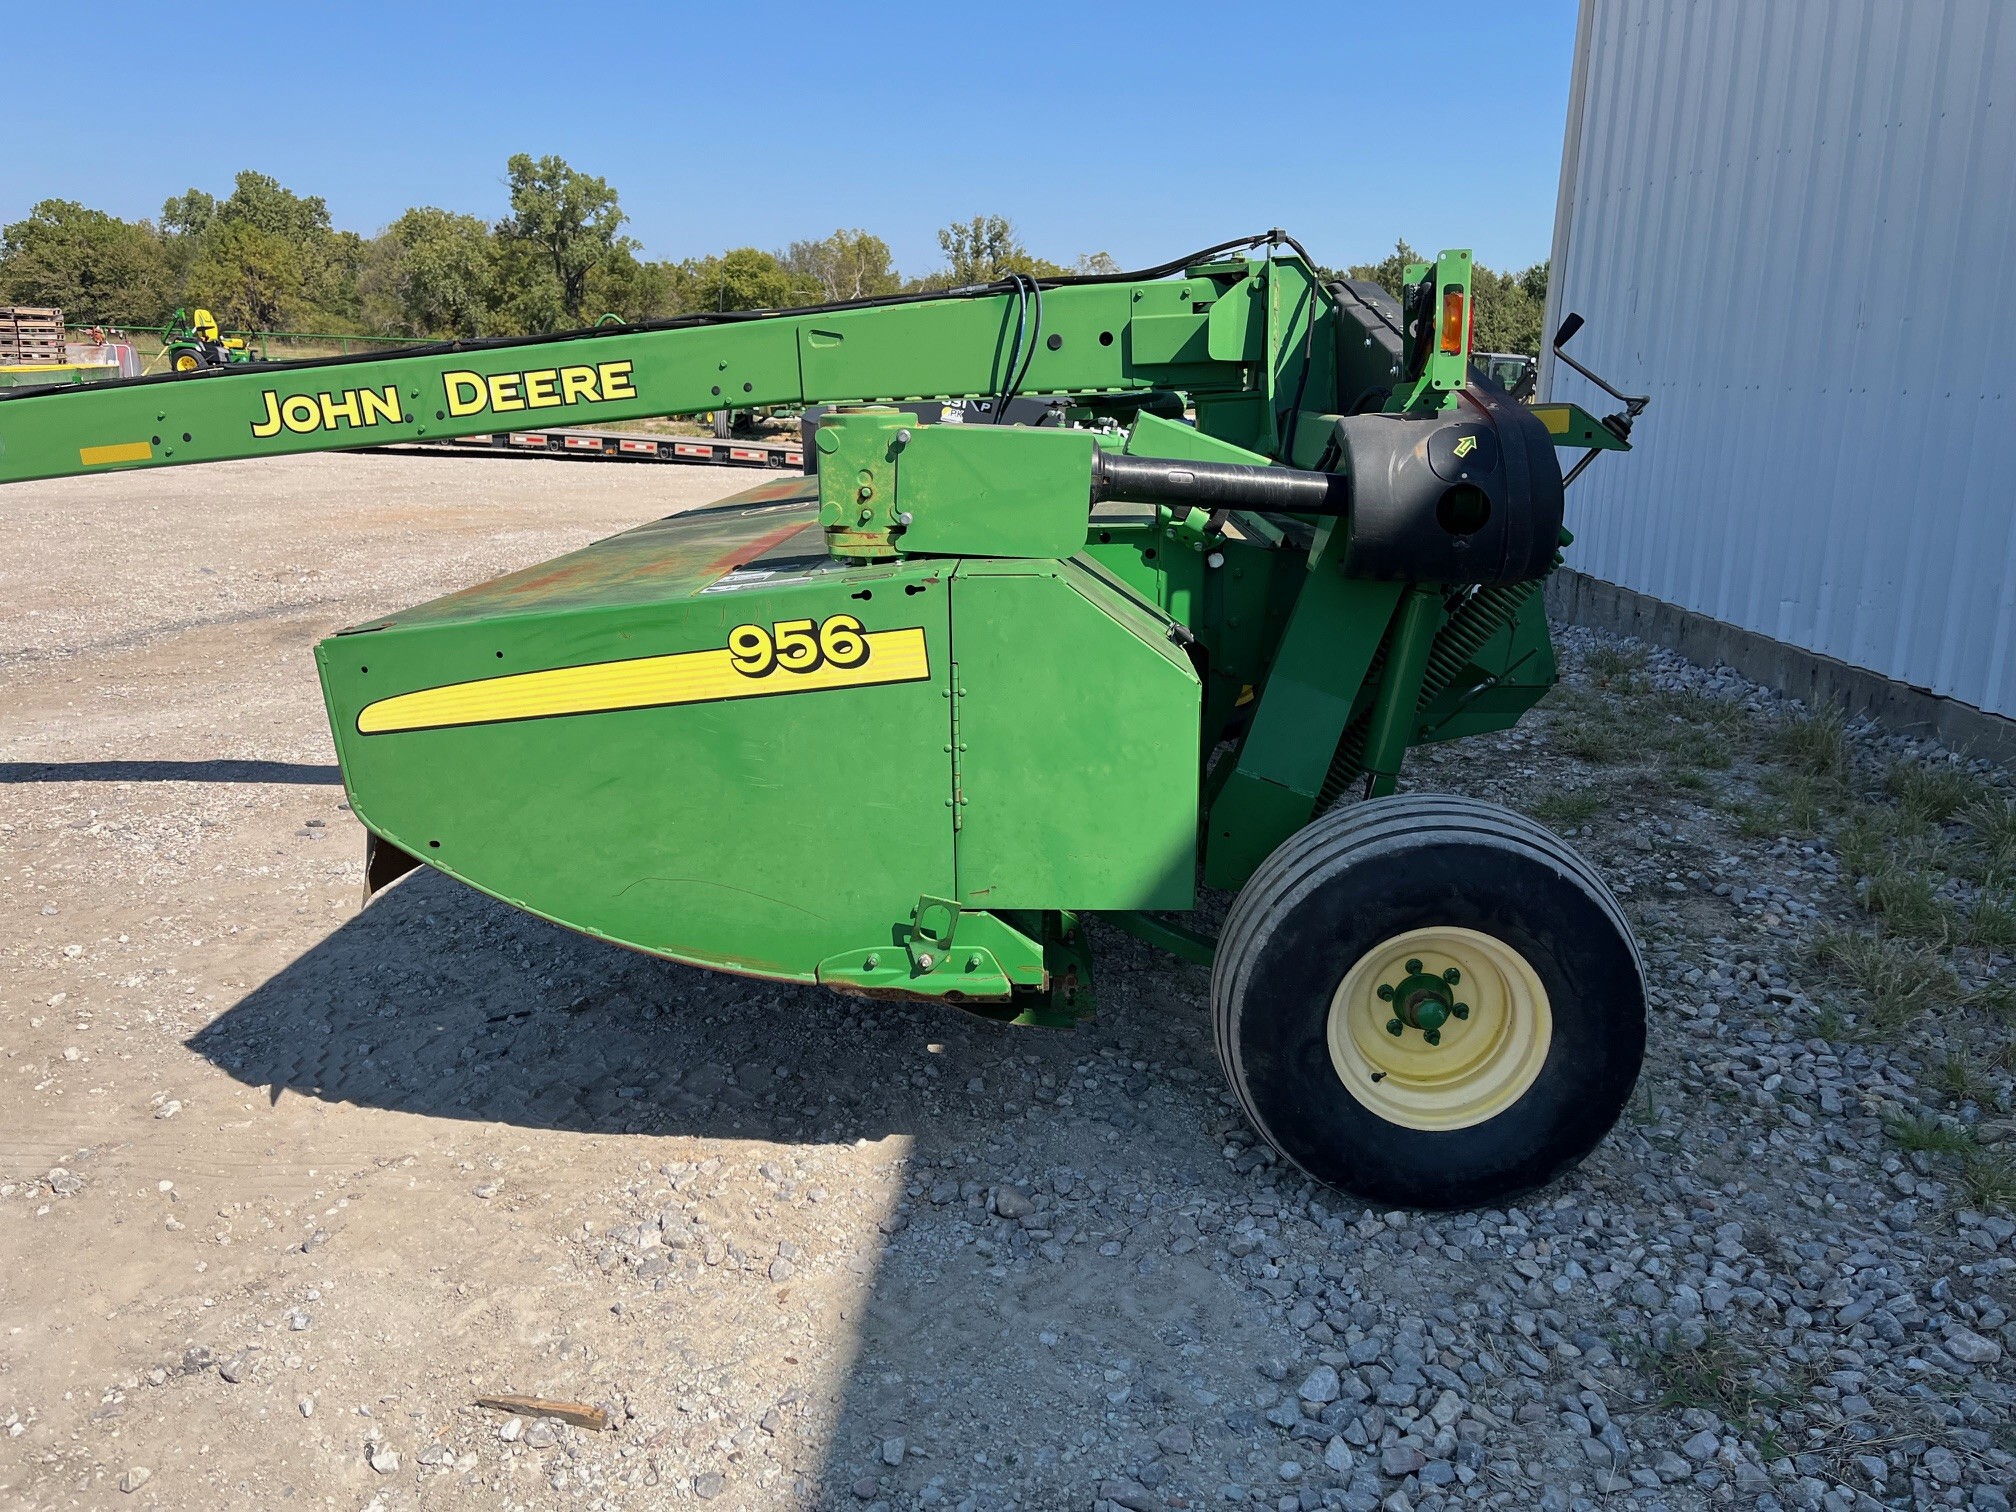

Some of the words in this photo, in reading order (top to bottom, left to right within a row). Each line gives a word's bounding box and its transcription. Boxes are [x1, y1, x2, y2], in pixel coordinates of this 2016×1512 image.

[250, 385, 403, 438] JOHN
[441, 359, 638, 418] DEERE
[727, 613, 871, 678] 956
